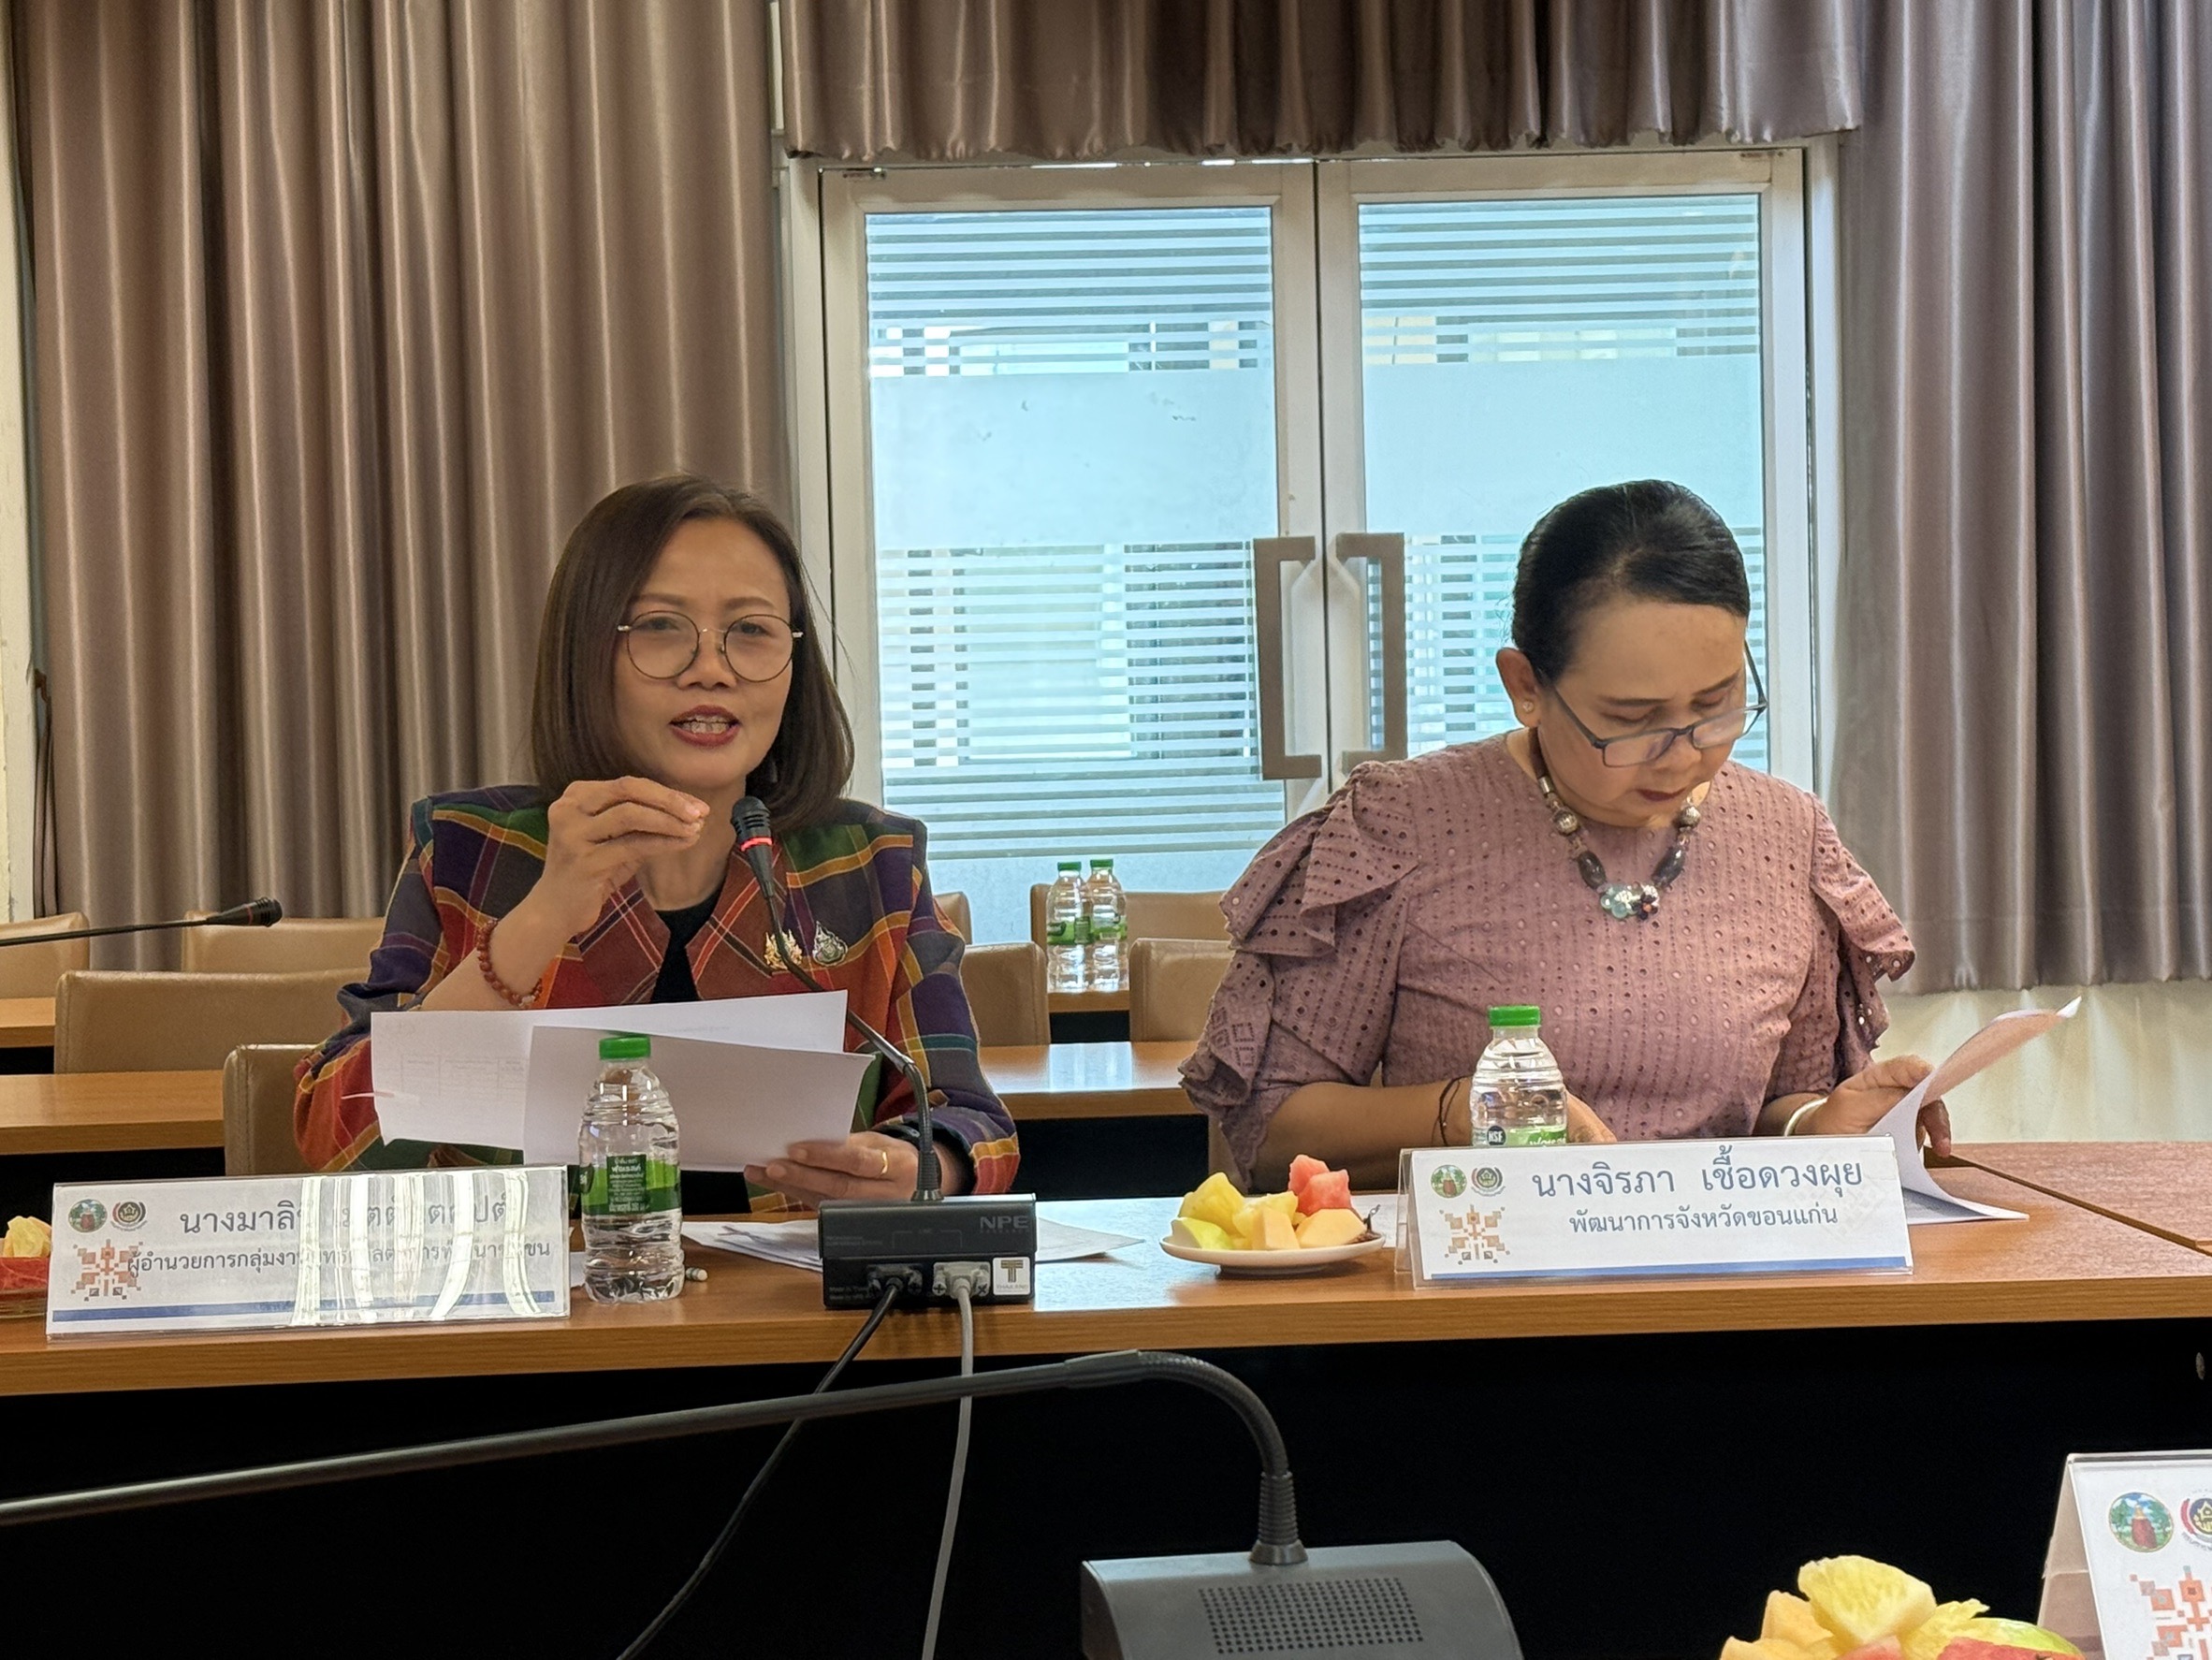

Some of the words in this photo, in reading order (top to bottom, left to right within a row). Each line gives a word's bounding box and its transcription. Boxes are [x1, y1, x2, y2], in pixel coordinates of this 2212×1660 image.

[1532, 1160, 1675, 1198] นางจิรภา
[1701, 1143, 1863, 1198] เชื้อดวงผุย
[979, 1215, 1030, 1230] NPE
[1569, 1201, 1839, 1233] พัฒนาการจังหวัดขอนแก่น
